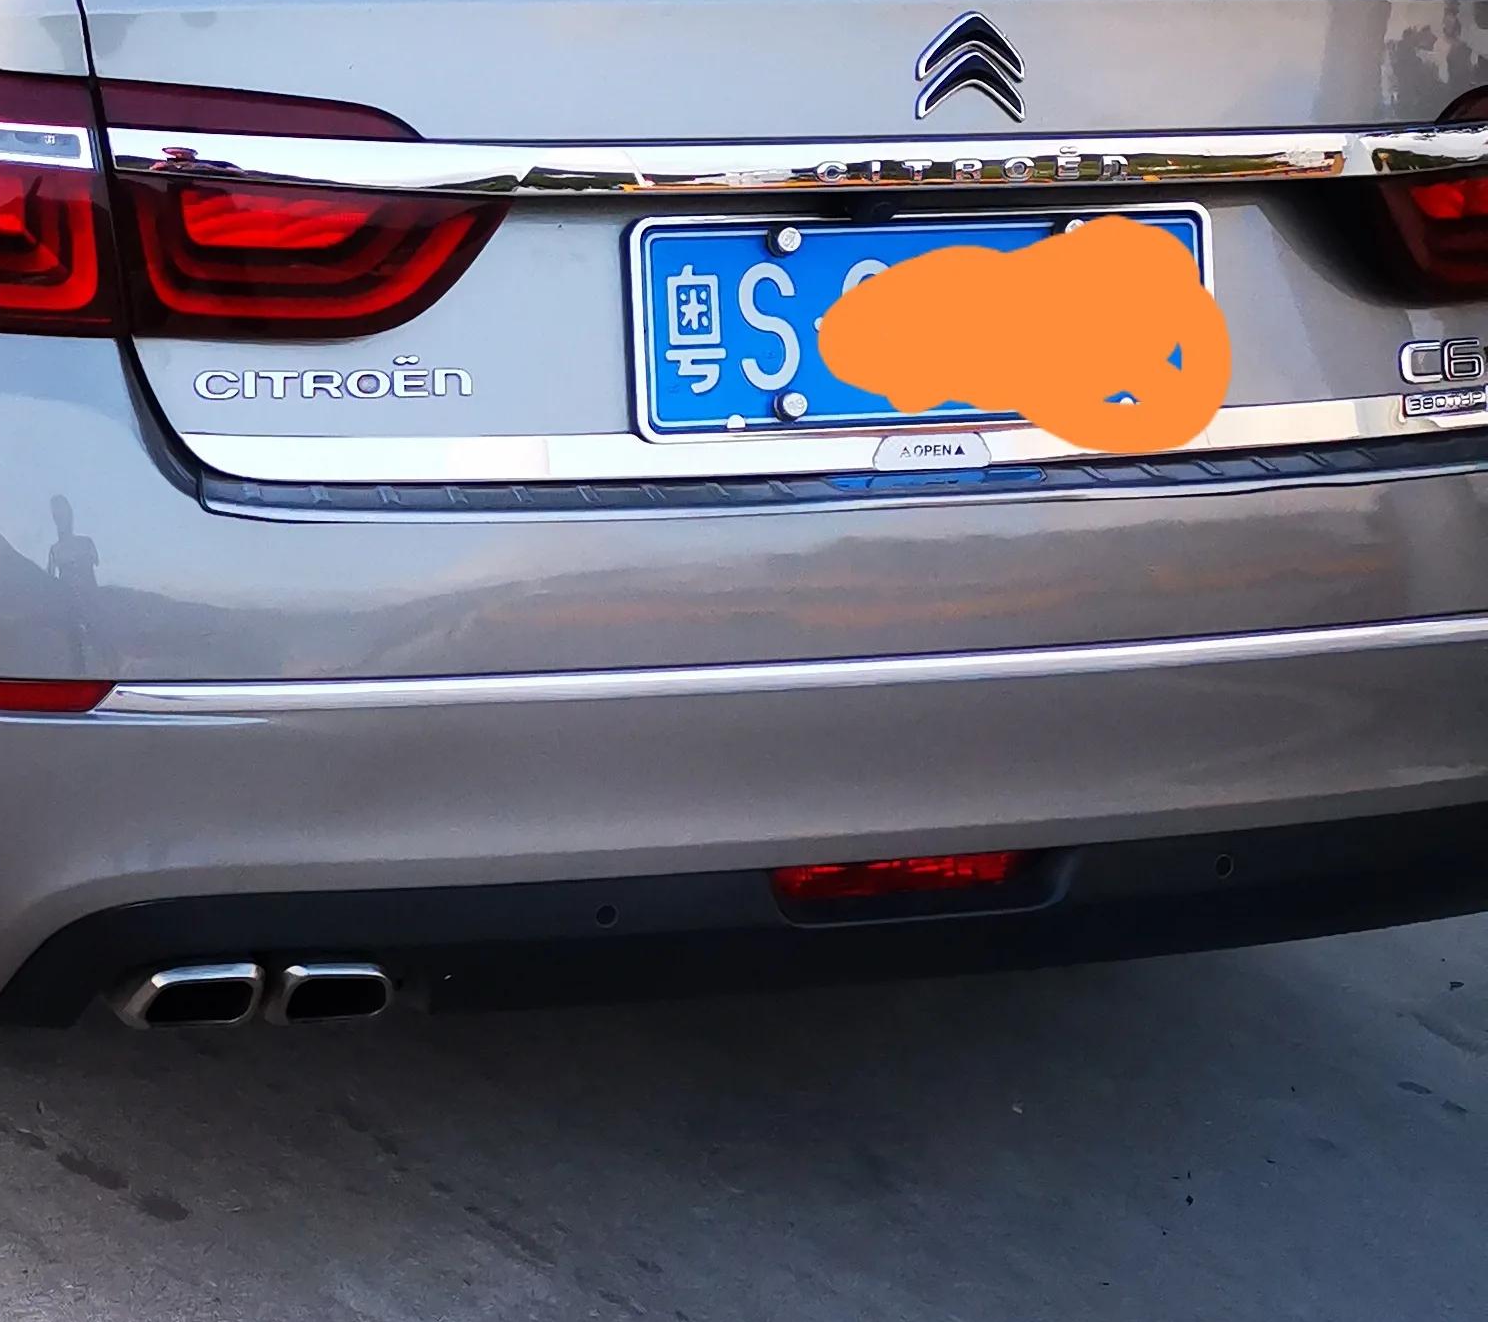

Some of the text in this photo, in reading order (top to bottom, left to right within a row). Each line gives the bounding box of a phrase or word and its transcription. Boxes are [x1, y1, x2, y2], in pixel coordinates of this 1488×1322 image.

[816, 145, 1129, 183] CITROËN
[193, 354, 473, 400] CITROËN
[1398, 338, 1484, 384] C6
[914, 444, 952, 457] OPEN
